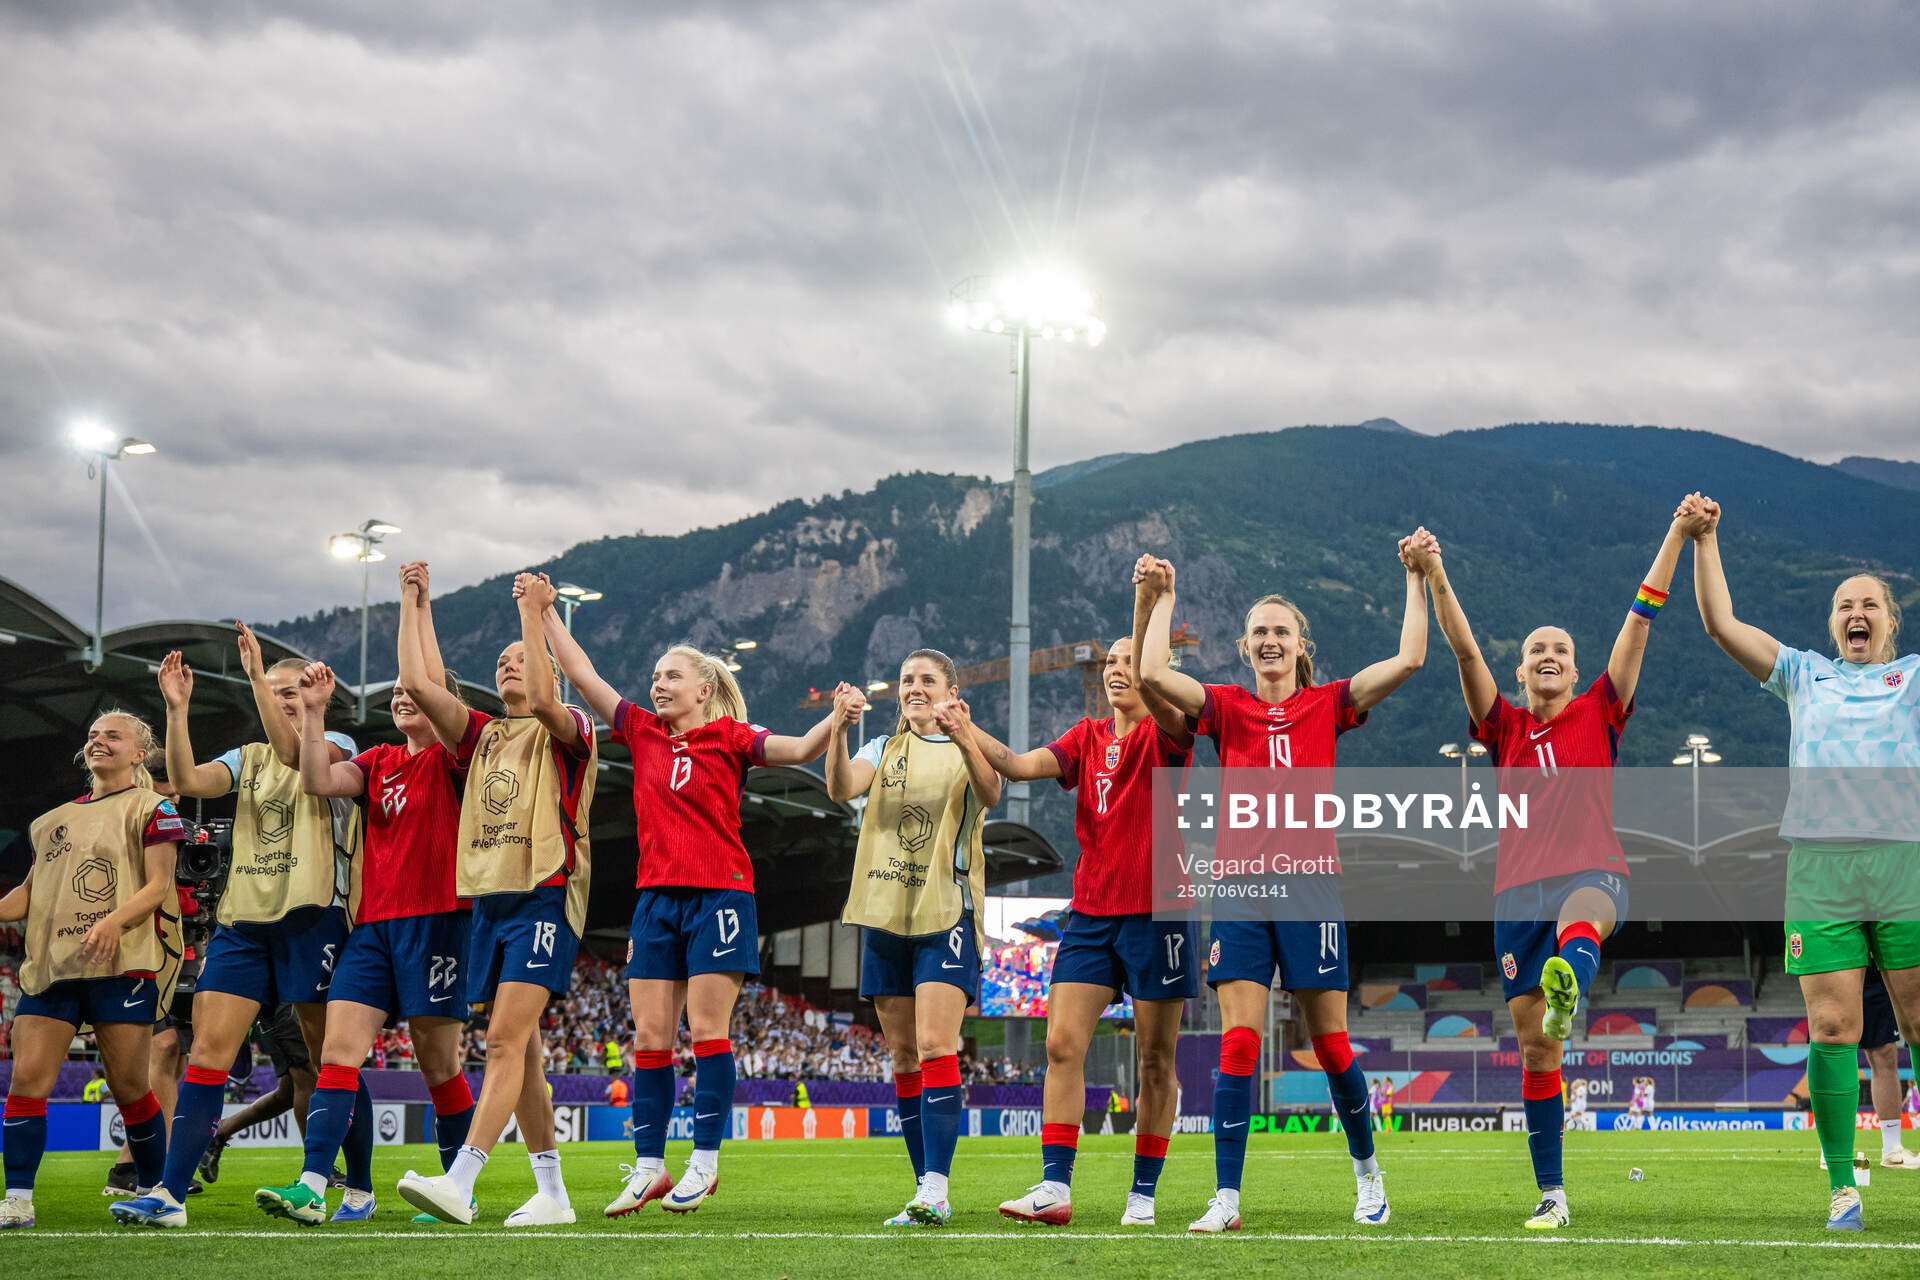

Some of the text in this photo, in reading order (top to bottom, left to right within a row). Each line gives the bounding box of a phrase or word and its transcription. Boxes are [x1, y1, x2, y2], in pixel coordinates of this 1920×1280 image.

[1267, 734, 1292, 771] 10
[1534, 741, 1559, 778] 11
[669, 756, 693, 791] 13
[381, 784, 407, 819] 22
[1096, 778, 1113, 815] 17
[254, 850, 292, 865] Togethe
[533, 921, 557, 958] 18
[715, 908, 740, 945] 13
[949, 926, 964, 960] 6
[1319, 922, 1338, 960] 10
[1164, 933, 1185, 970] 17
[429, 955, 458, 990] 22
[1490, 1051, 1693, 1067] THE MIT OF EMOTIONS
[999, 1109, 1043, 1137] GRIFOL
[1177, 1115, 1212, 1133] FOOTB
[1249, 1115, 1322, 1133] PLAY
[1419, 1116, 1497, 1132] HUBLOT
[1650, 1115, 1765, 1131] Volkswagen
